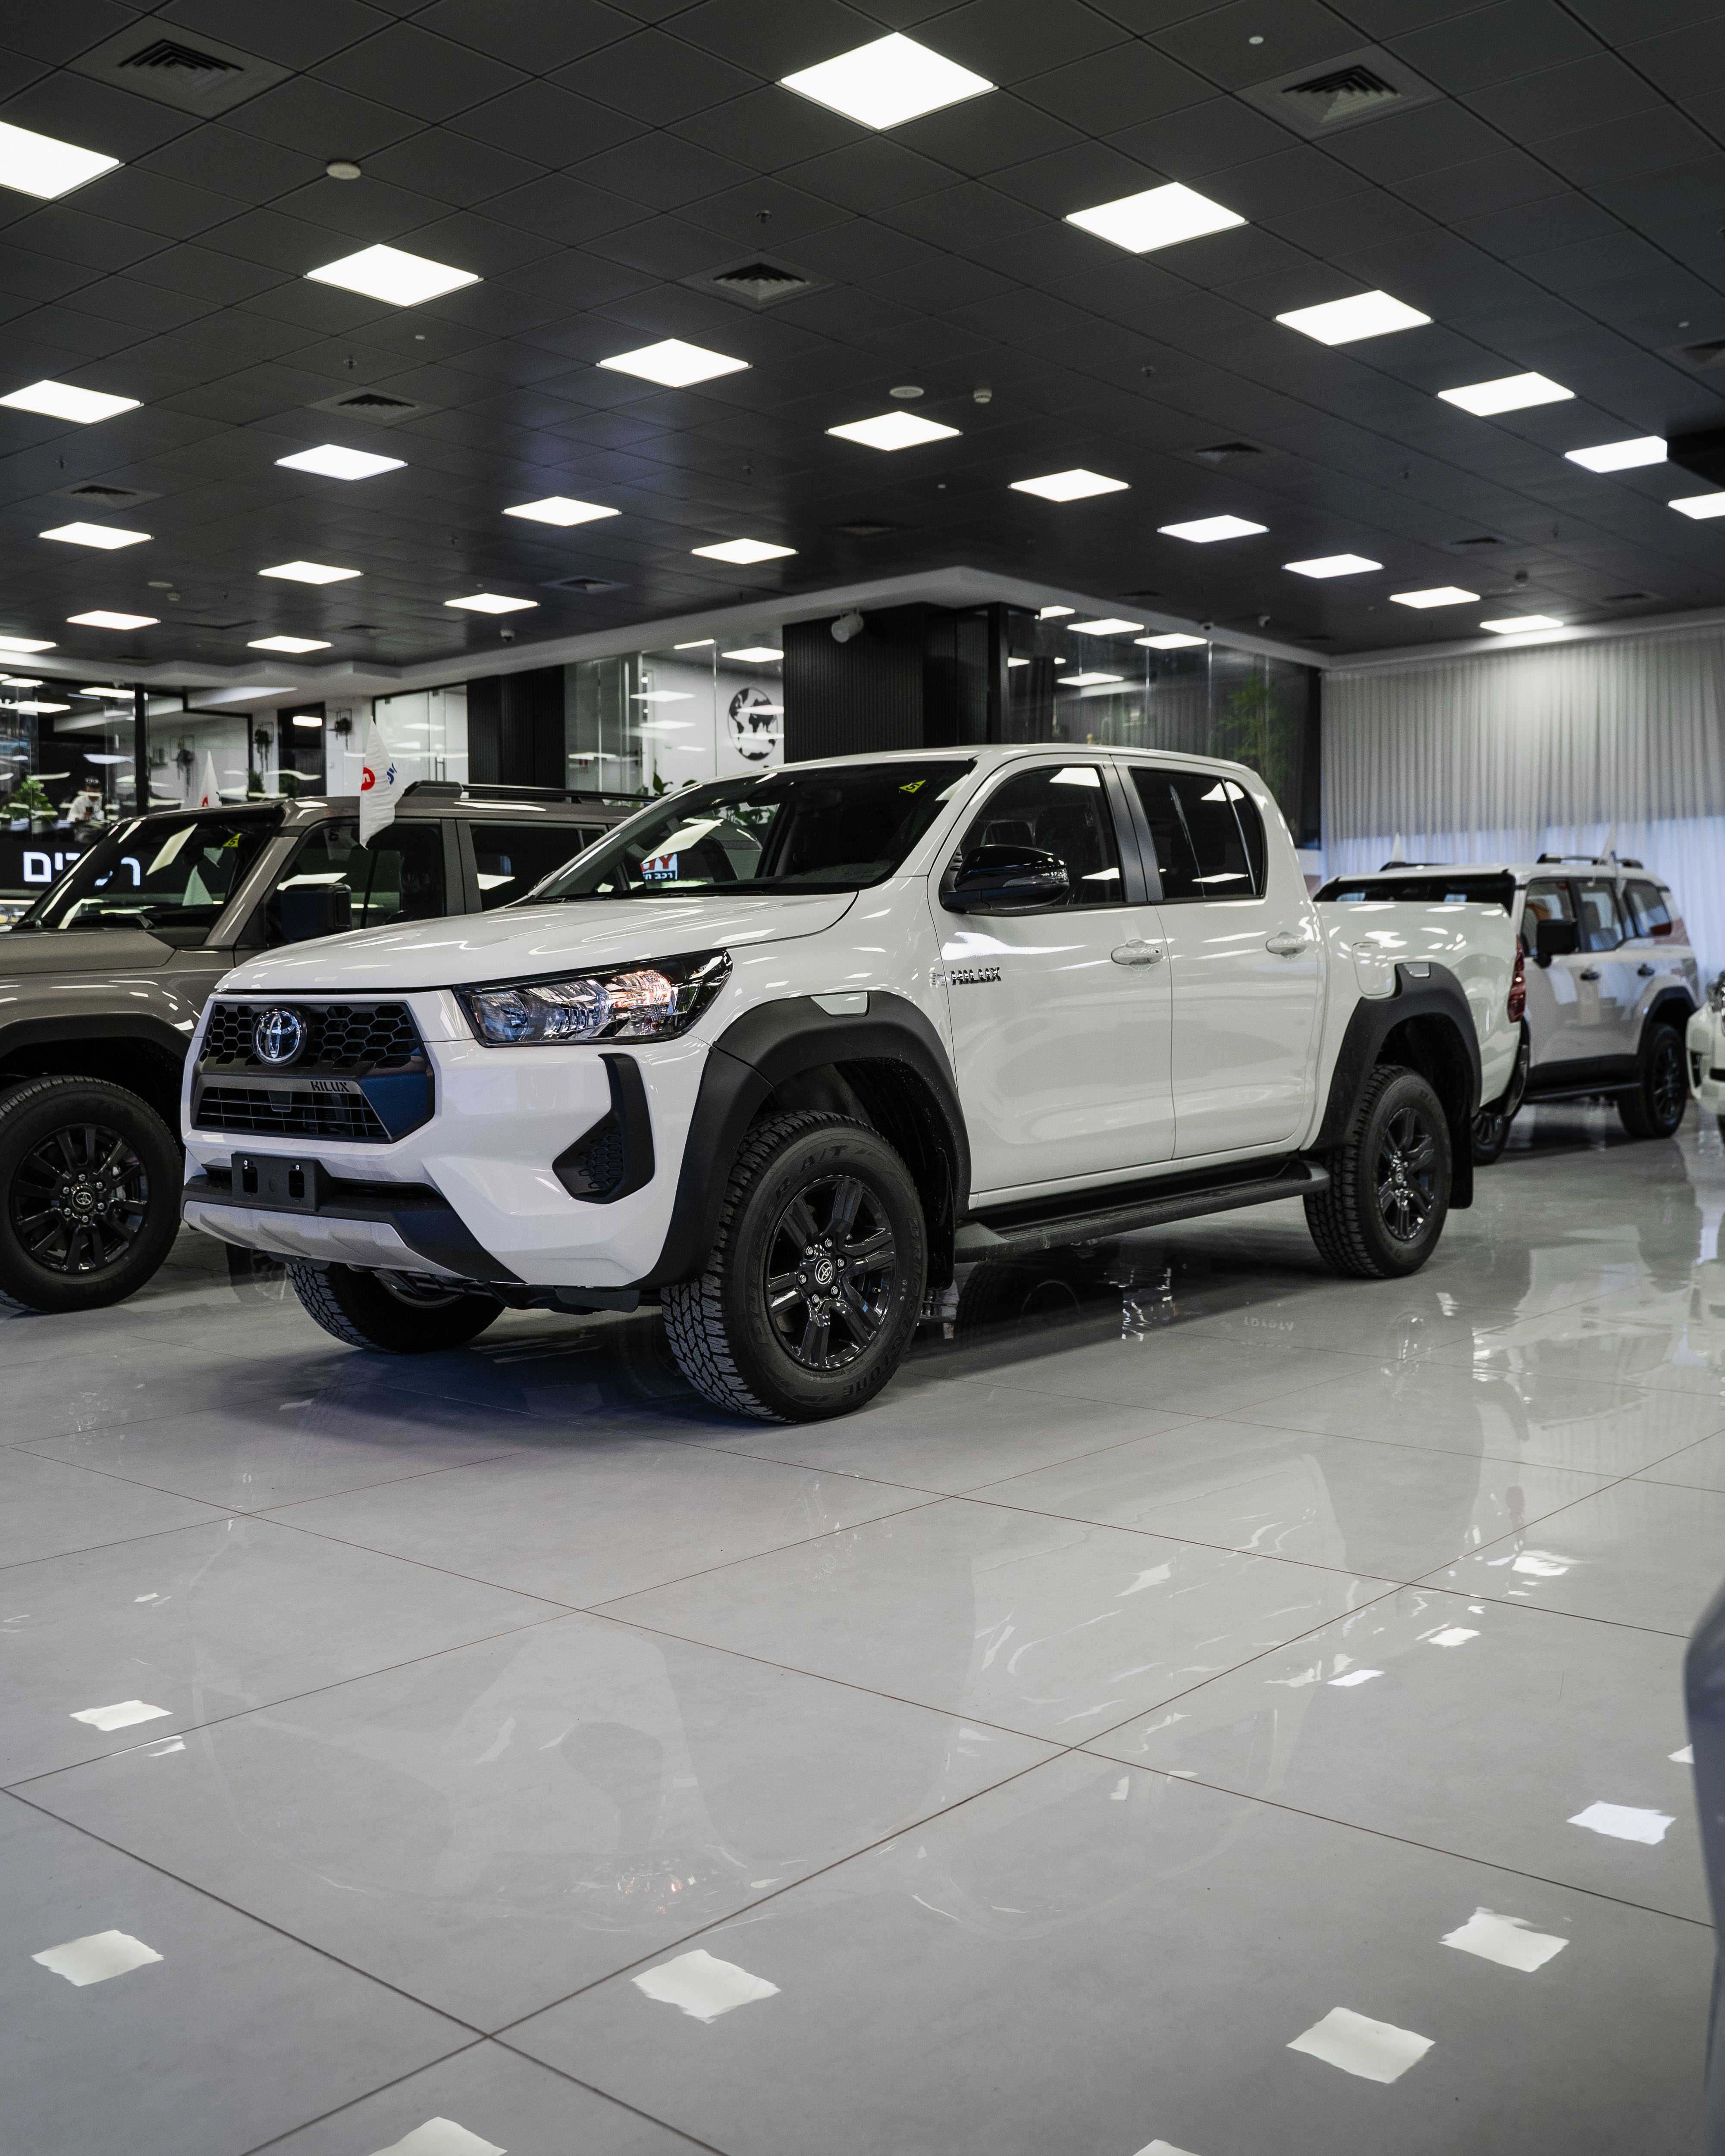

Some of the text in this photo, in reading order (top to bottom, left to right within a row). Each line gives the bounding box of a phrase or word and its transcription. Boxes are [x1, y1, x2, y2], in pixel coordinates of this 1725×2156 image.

[950, 967, 1001, 985] HILUX
[310, 1081, 350, 1092] HILUX
[748, 1144, 848, 1344] DUELER A/T
[843, 1217, 923, 1400] BRIDGESTONE
